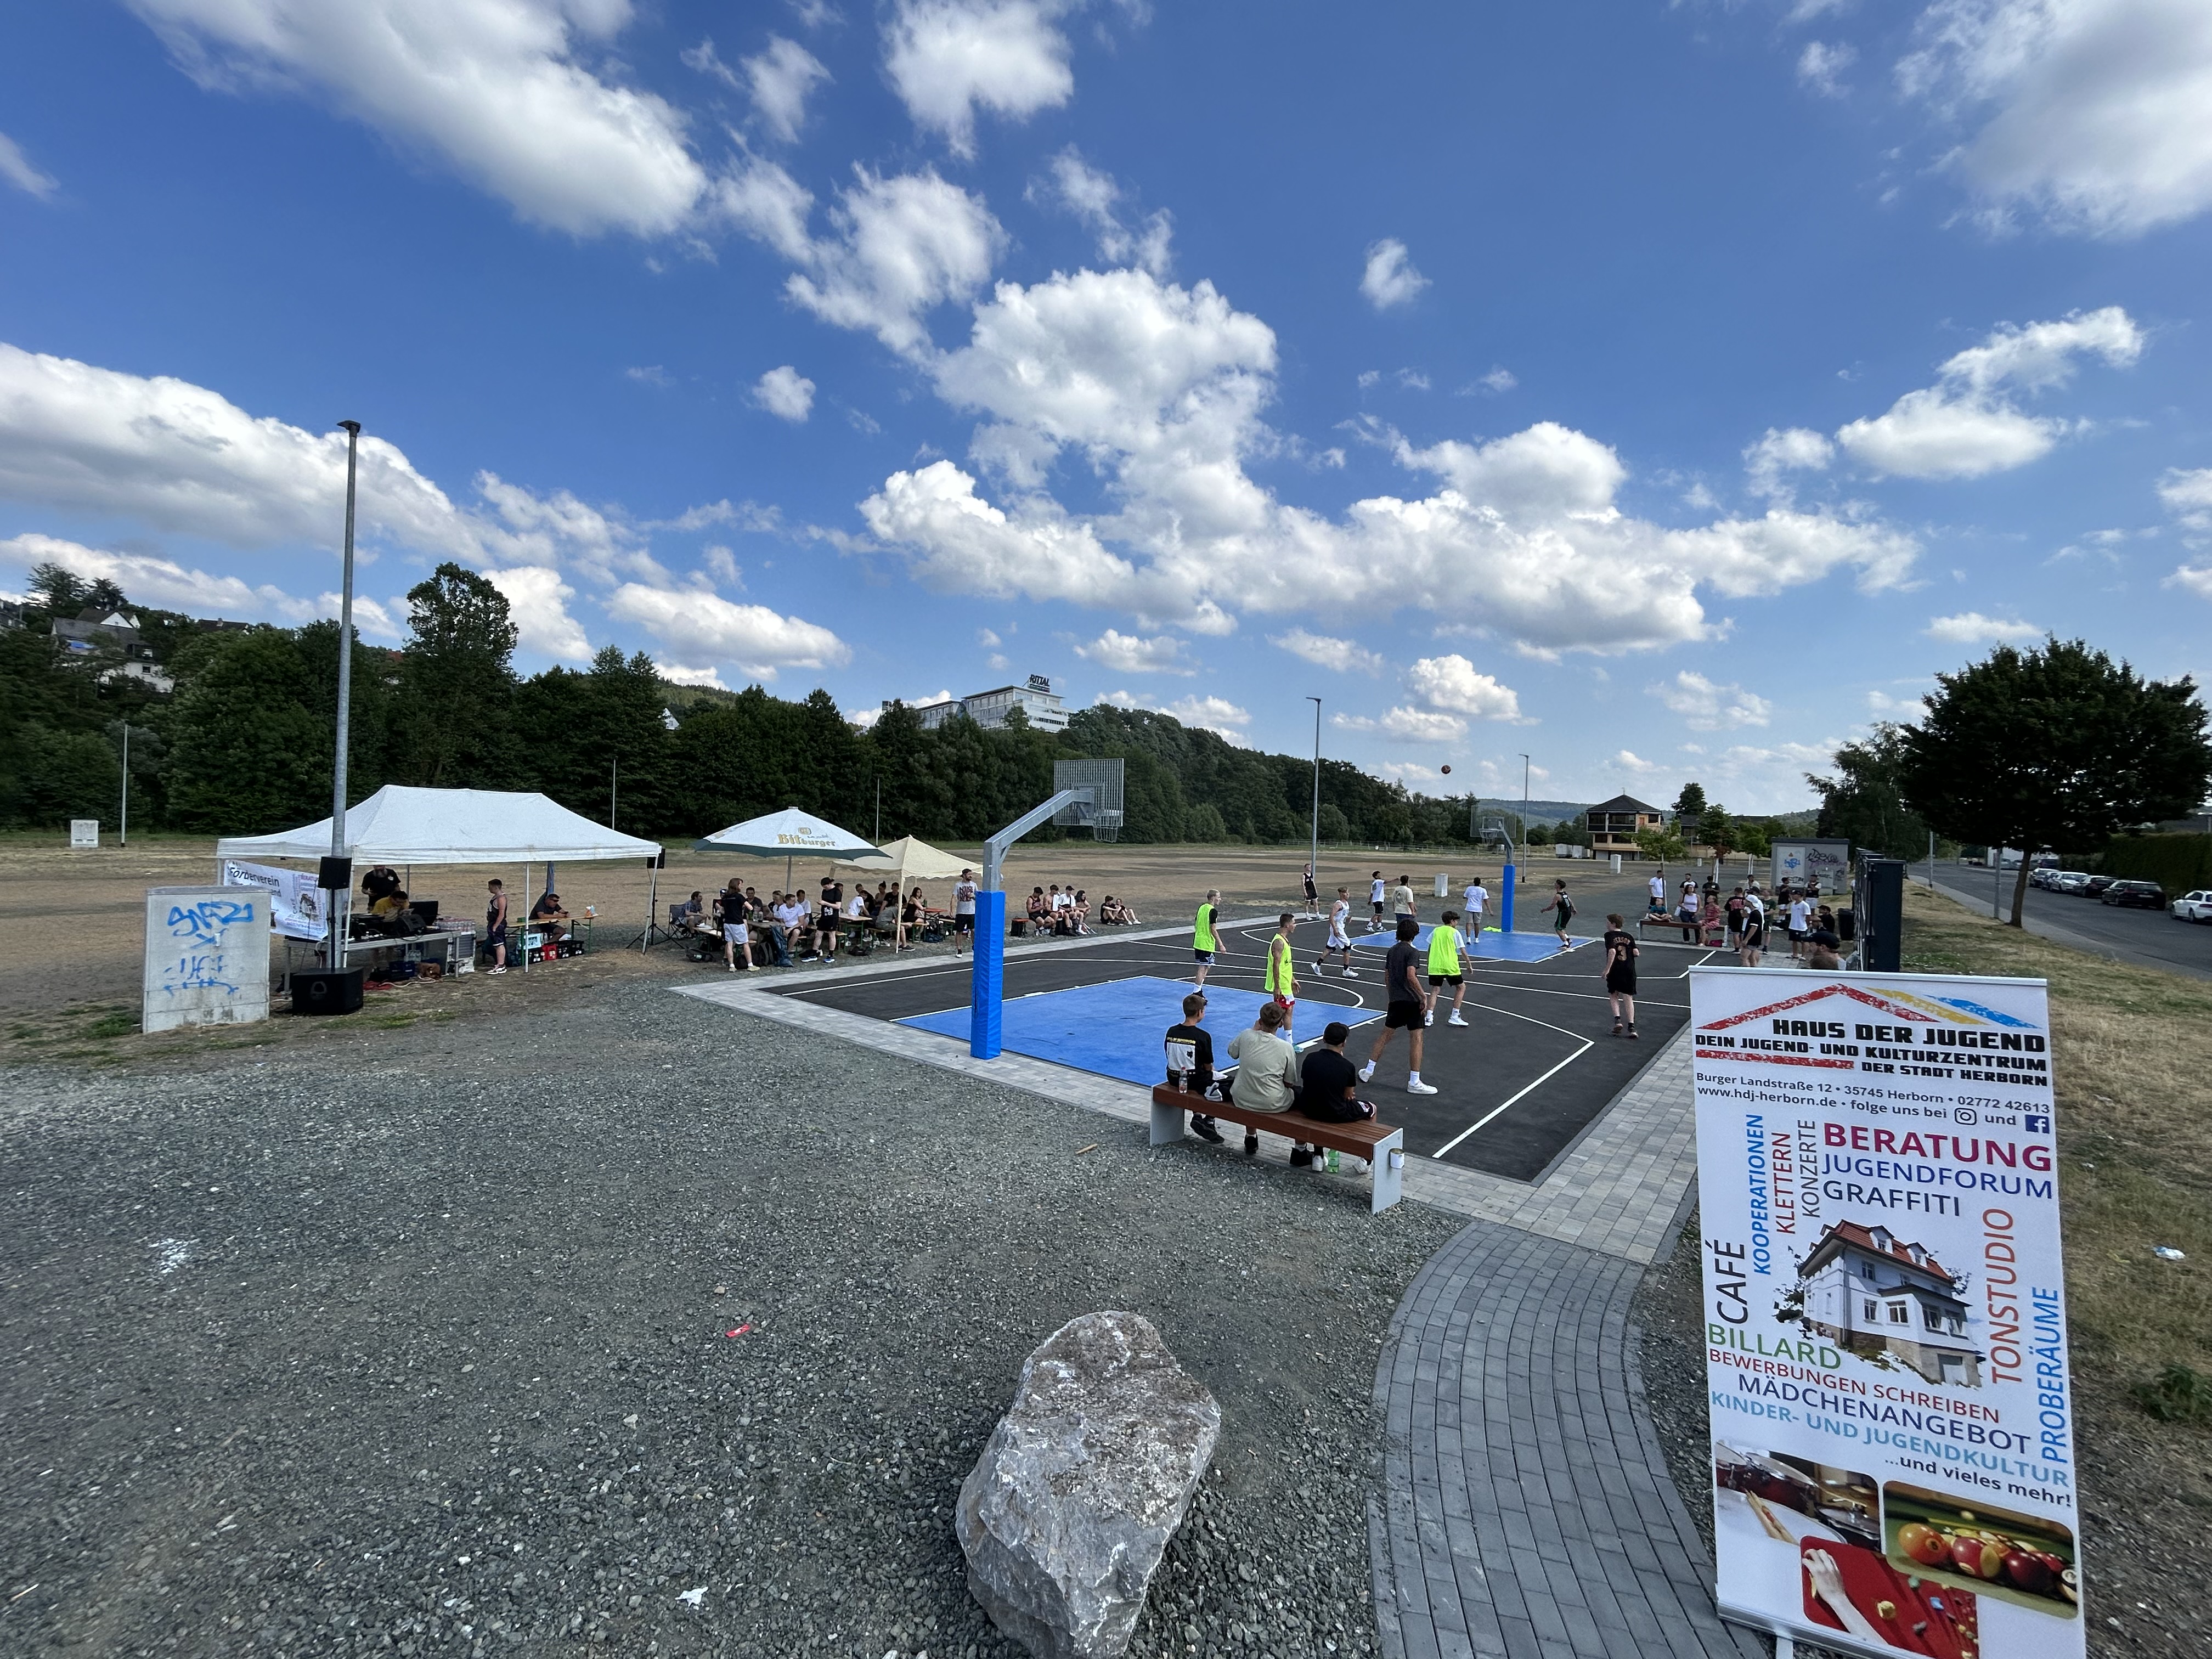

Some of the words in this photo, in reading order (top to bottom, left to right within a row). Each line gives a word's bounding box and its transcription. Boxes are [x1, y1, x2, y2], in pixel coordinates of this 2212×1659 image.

[777, 834, 836, 847] Bitburger
[1695, 1034, 1735, 1048] DEIN
[1740, 1037, 1814, 1053] JUGEND-
[1820, 1043, 1859, 1057] UND
[1865, 1046, 2047, 1071] KULTURZENTRUM
[1773, 1019, 1845, 1038] HAUS
[1855, 1024, 1914, 1043] DER
[1923, 1028, 2045, 1053] JUGEND
[1696, 1073, 1737, 1085] Burger
[1740, 1076, 1813, 1091] Landstraße
[1817, 1083, 1832, 1093] 12
[1844, 1086, 1883, 1098] 35745
[1888, 1090, 1944, 1103] Herborn
[1957, 1096, 2000, 1108] 02772
[2005, 1101, 2050, 1114] 42613
[1862, 1062, 1895, 1074] DER
[1900, 1064, 1955, 1079] STADT
[1960, 1069, 2048, 1086] HERBORN
[1697, 1086, 1837, 1107] www.hdj-herborn.de
[1850, 1099, 1887, 1115] folge
[1892, 1106, 1920, 1116] uns
[1924, 1106, 1947, 1118] bei
[1984, 1115, 2017, 1125] und
[1797, 1119, 1820, 1218] KONZERTE
[1824, 1122, 2051, 1171] BERATUNG
[1746, 1114, 1771, 1276] KOOPERATIONEN
[1771, 1132, 1796, 1234] KLETTERN
[1822, 1153, 2052, 1199] JUGENDFORUM
[1823, 1180, 1960, 1217] GRAFFITI
[1706, 1239, 1749, 1324] CAFÉ
[1983, 1207, 2022, 1384] TONSTUDIO
[1708, 1323, 1841, 1370] BILLARD
[1710, 1349, 1866, 1395] BEWERBUNGEN
[1874, 1384, 1999, 1423] SCHREIBEN
[2028, 1286, 2067, 1464] PROBERÄUME
[1739, 1371, 2030, 1454] MÄDCHENANGEBOT
[1711, 1391, 1799, 1423] KINDER-
[1806, 1413, 1858, 1438] UND
[1863, 1427, 2069, 1488] JUGENDKULTUR
[1943, 1462, 2001, 1491] vieles
[2008, 1481, 2072, 1507] mehr!
